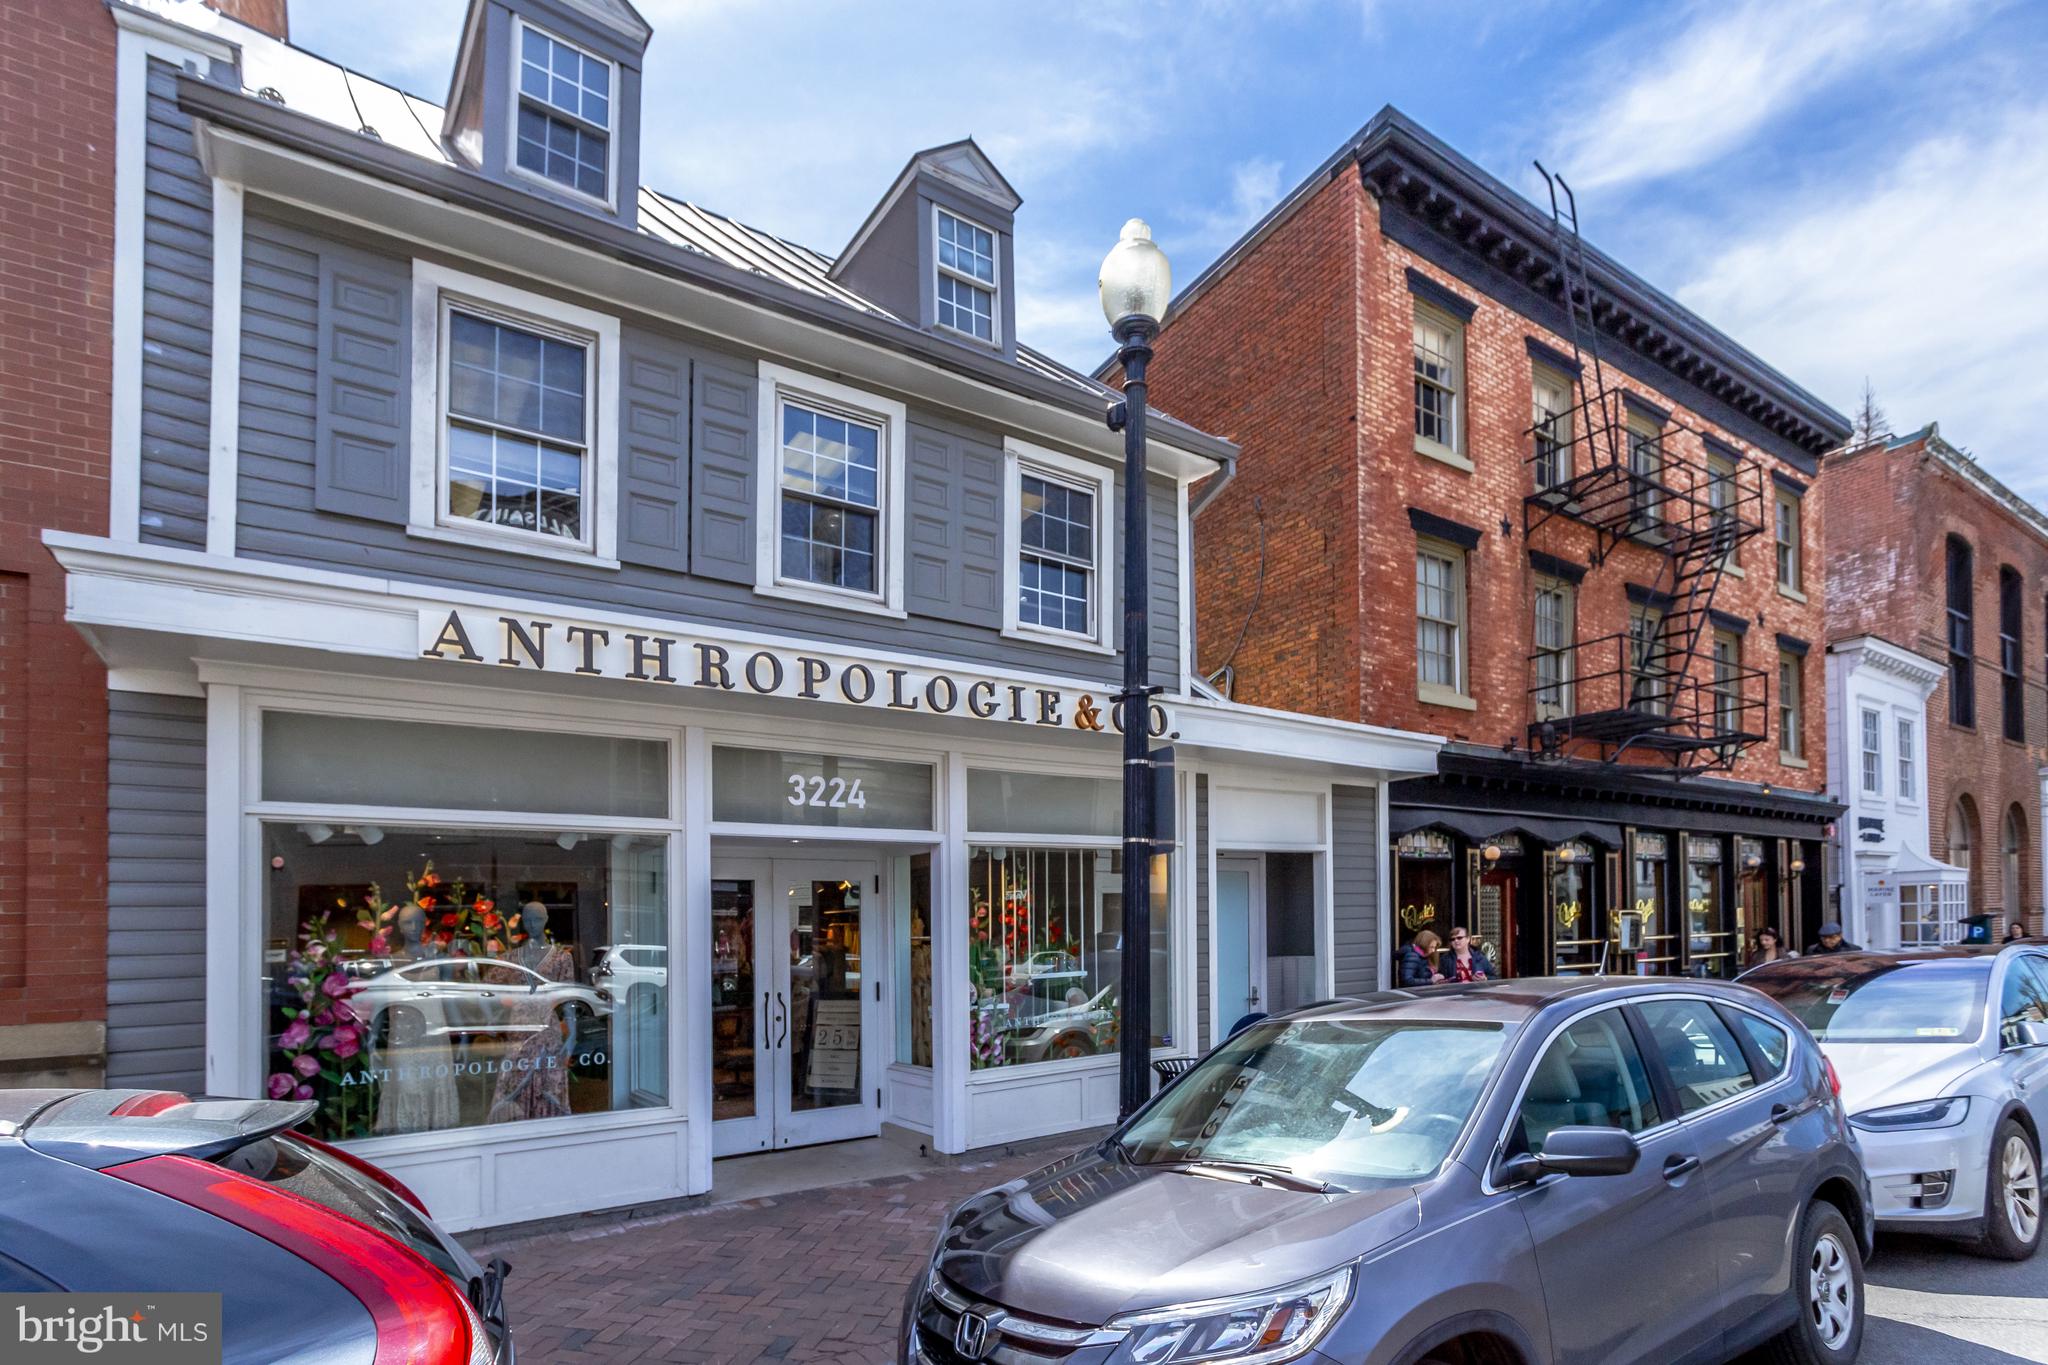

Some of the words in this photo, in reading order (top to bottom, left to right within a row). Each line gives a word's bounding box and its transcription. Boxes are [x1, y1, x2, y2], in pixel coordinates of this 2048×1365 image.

[423, 609, 1062, 726] ANTHROPOLOGIE
[1075, 694, 1104, 731] &
[787, 774, 866, 809] 3224
[1973, 926, 1985, 938] P
[339, 1055, 558, 1087] ANTHROPOLOGIE
[579, 1052, 611, 1067] CO.
